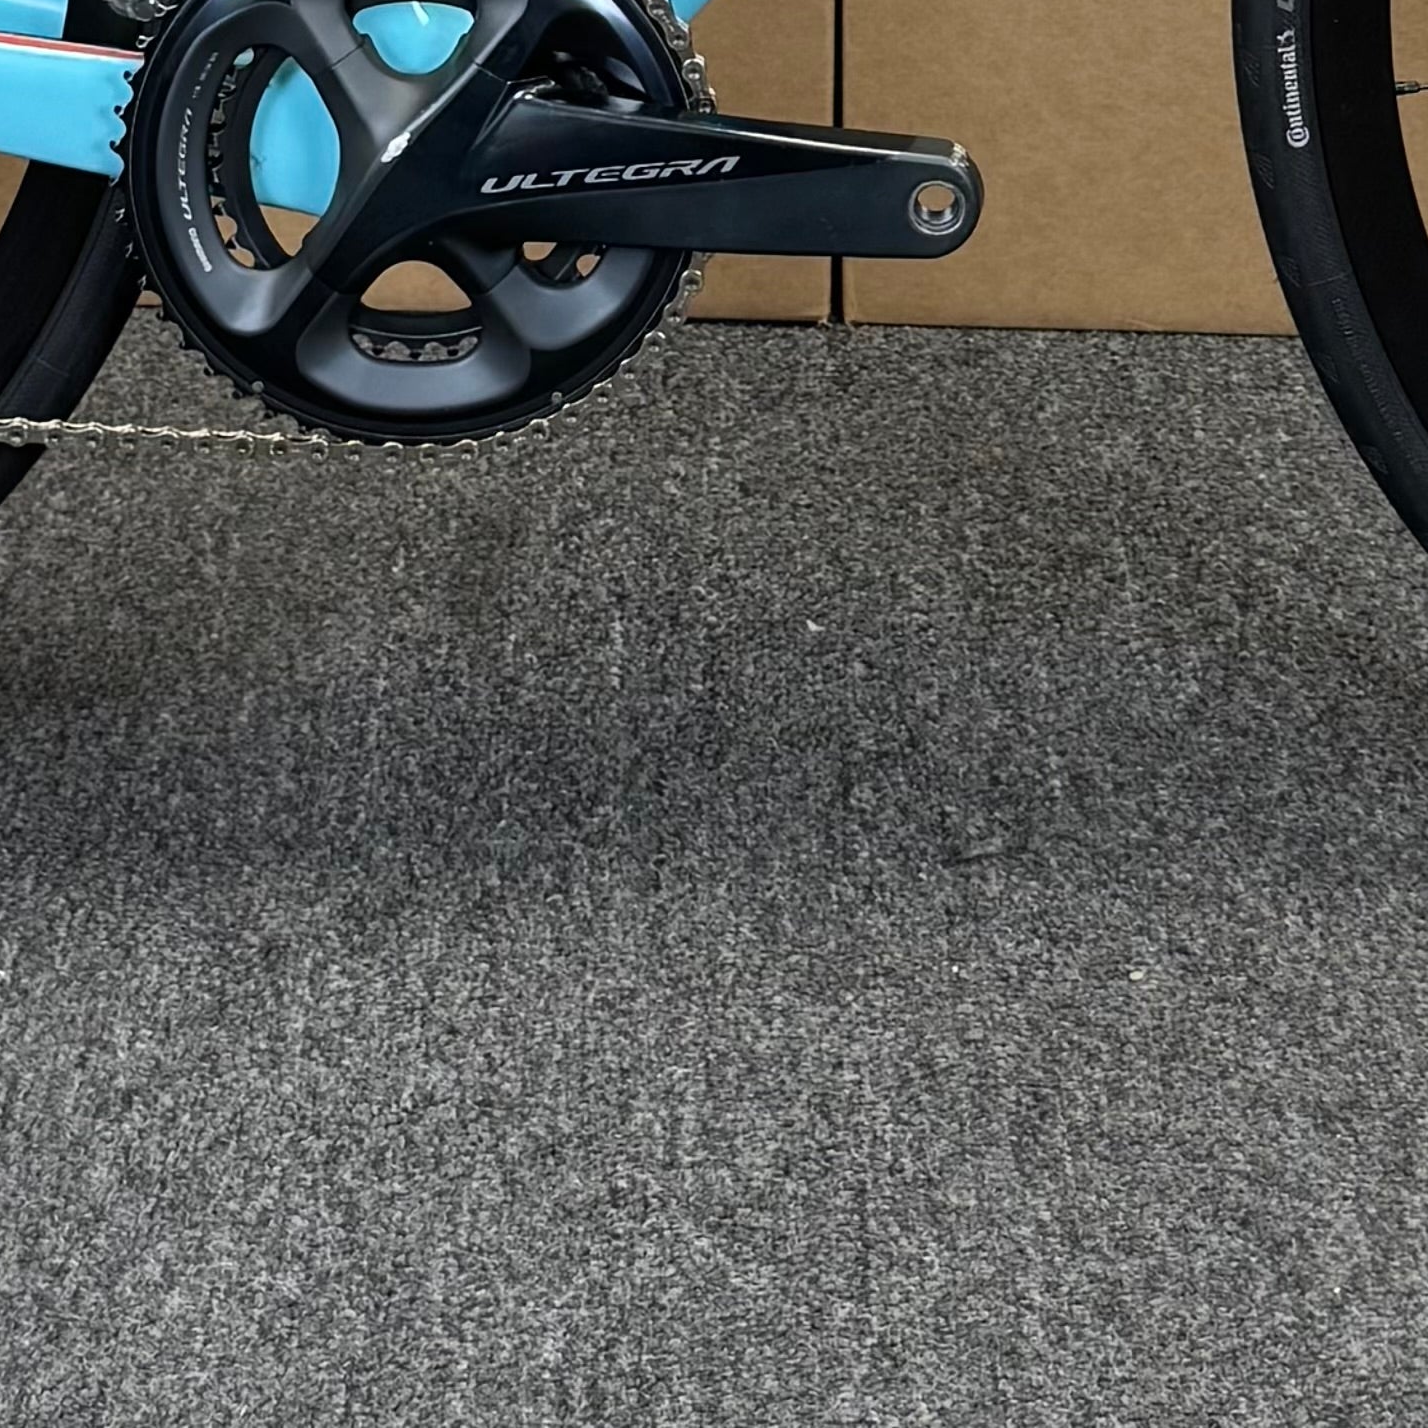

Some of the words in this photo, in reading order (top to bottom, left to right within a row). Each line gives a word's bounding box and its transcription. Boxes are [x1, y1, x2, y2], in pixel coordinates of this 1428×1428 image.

[1276, 41, 1310, 148] Continental
[180, 105, 194, 221] ULTEGRA
[480, 155, 740, 195] ULTEGRA
